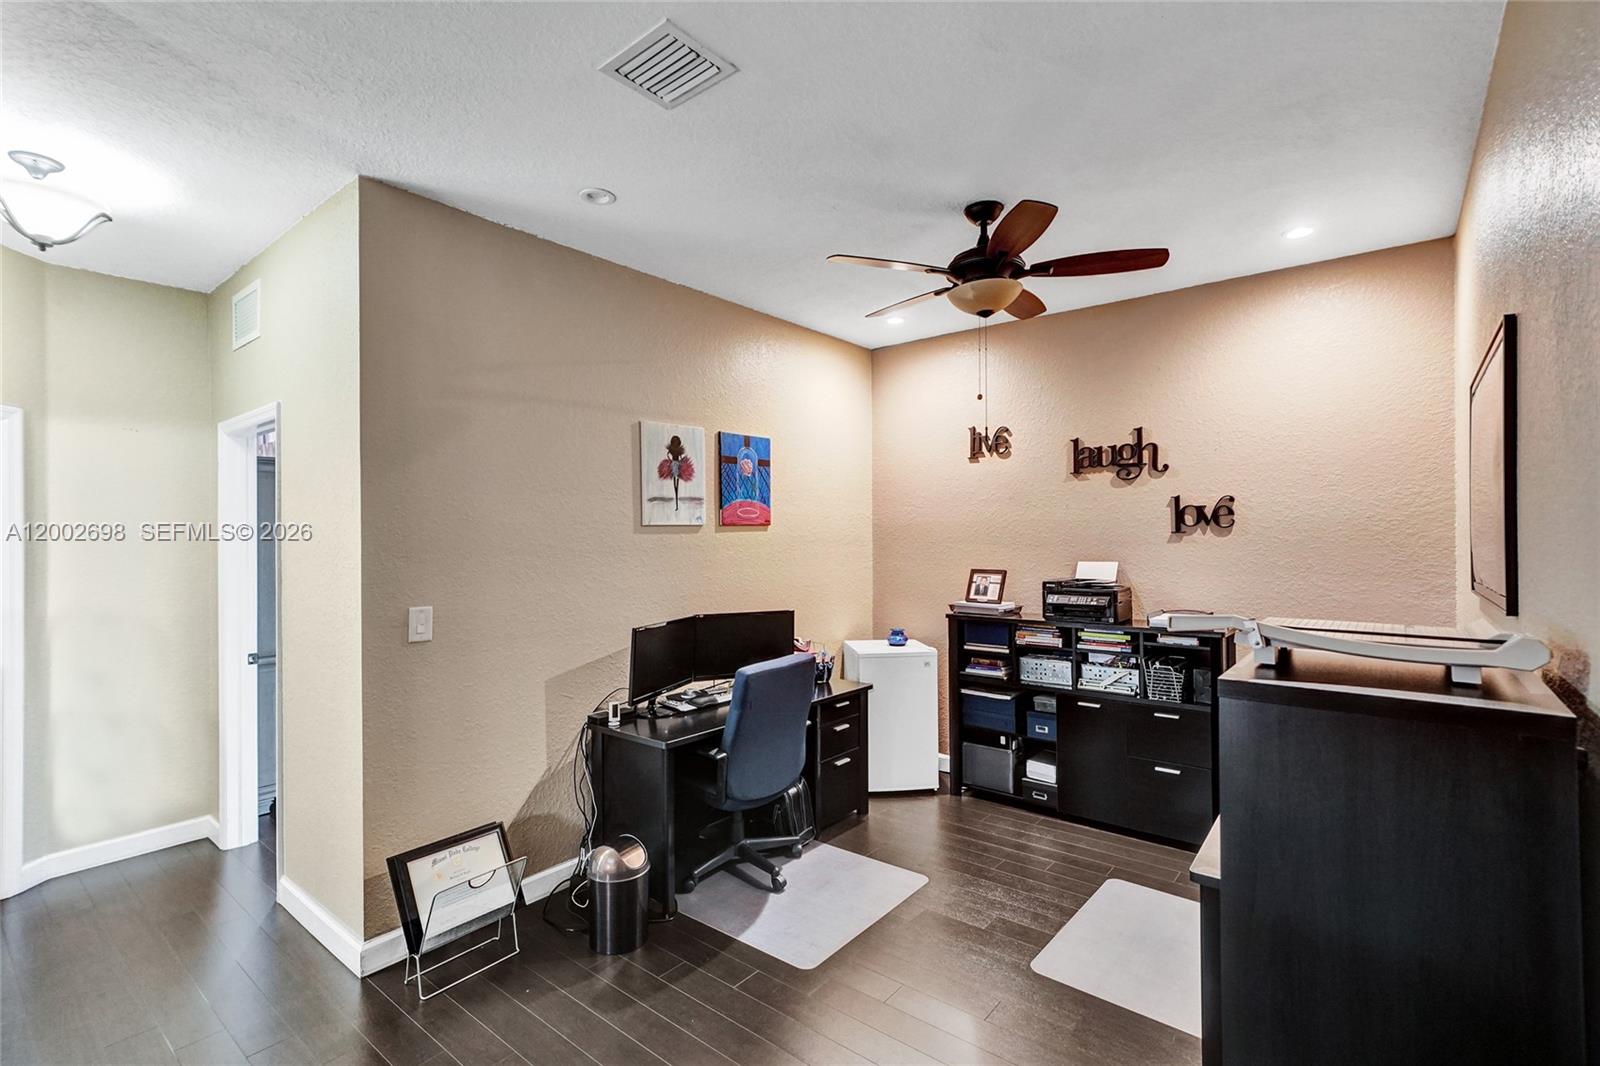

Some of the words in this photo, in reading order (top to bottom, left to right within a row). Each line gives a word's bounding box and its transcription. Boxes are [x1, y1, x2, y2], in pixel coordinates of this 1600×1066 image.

[969, 426, 1010, 459] live
[1070, 426, 1169, 480] laugh
[1171, 495, 1235, 533] love
